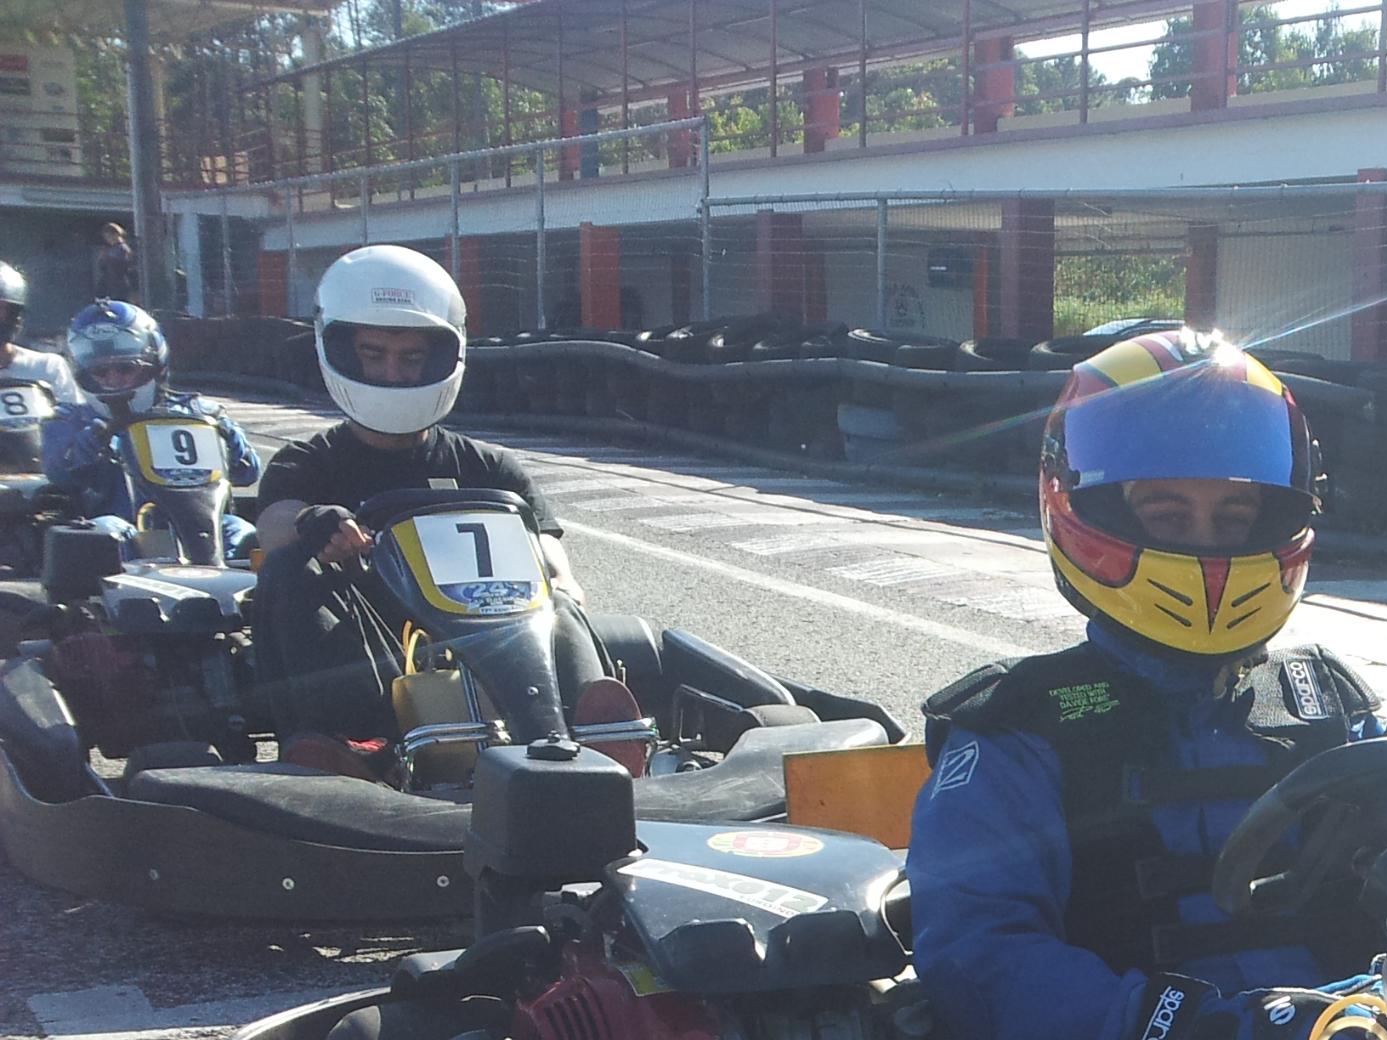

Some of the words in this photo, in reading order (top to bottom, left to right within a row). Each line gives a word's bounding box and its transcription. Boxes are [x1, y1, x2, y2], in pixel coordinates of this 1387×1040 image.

[1, 391, 28, 416] 8
[171, 429, 198, 466] 9
[456, 522, 494, 578] 7
